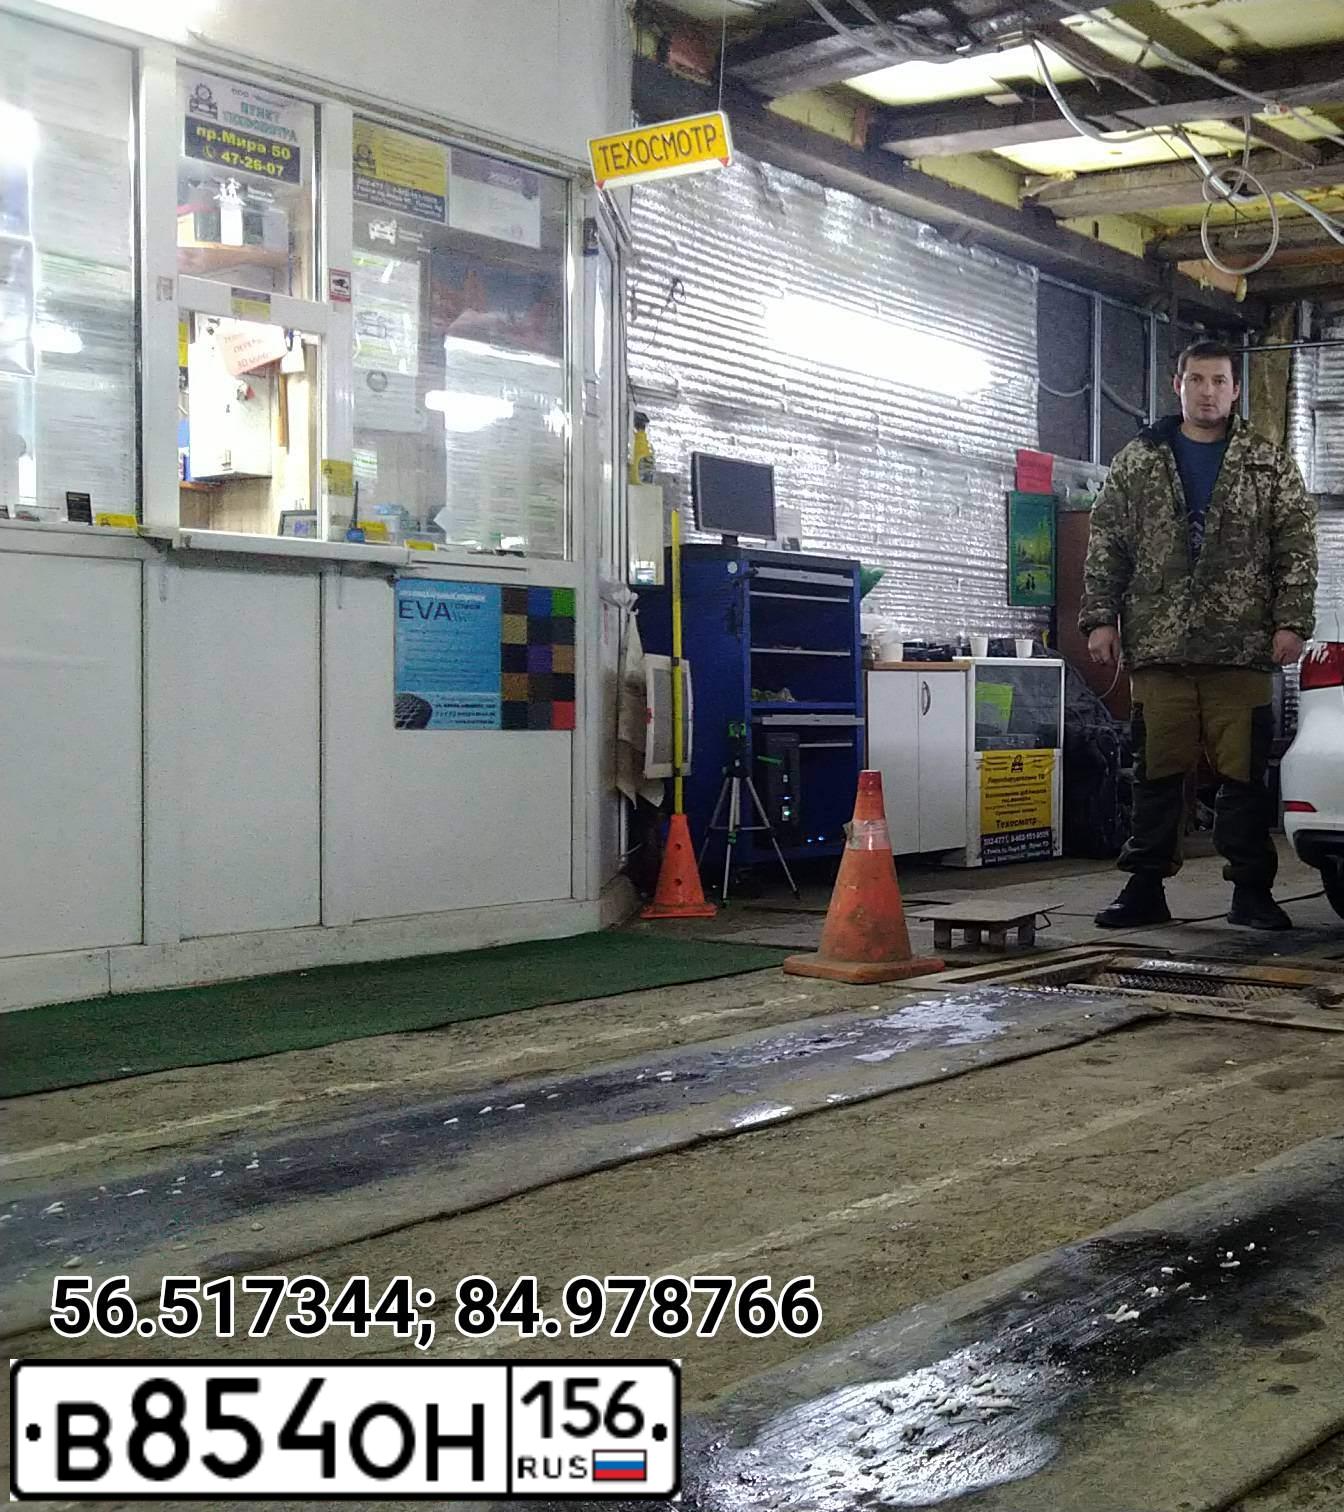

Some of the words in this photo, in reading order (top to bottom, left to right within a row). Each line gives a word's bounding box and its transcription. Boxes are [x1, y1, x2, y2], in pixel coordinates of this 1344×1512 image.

[196, 126, 267, 154] пр.Мира
[271, 144, 291, 160] 50
[598, 123, 717, 173] ТЕХОСМОТР
[221, 151, 284, 177] 47-26-07
[398, 599, 451, 621] EVA
